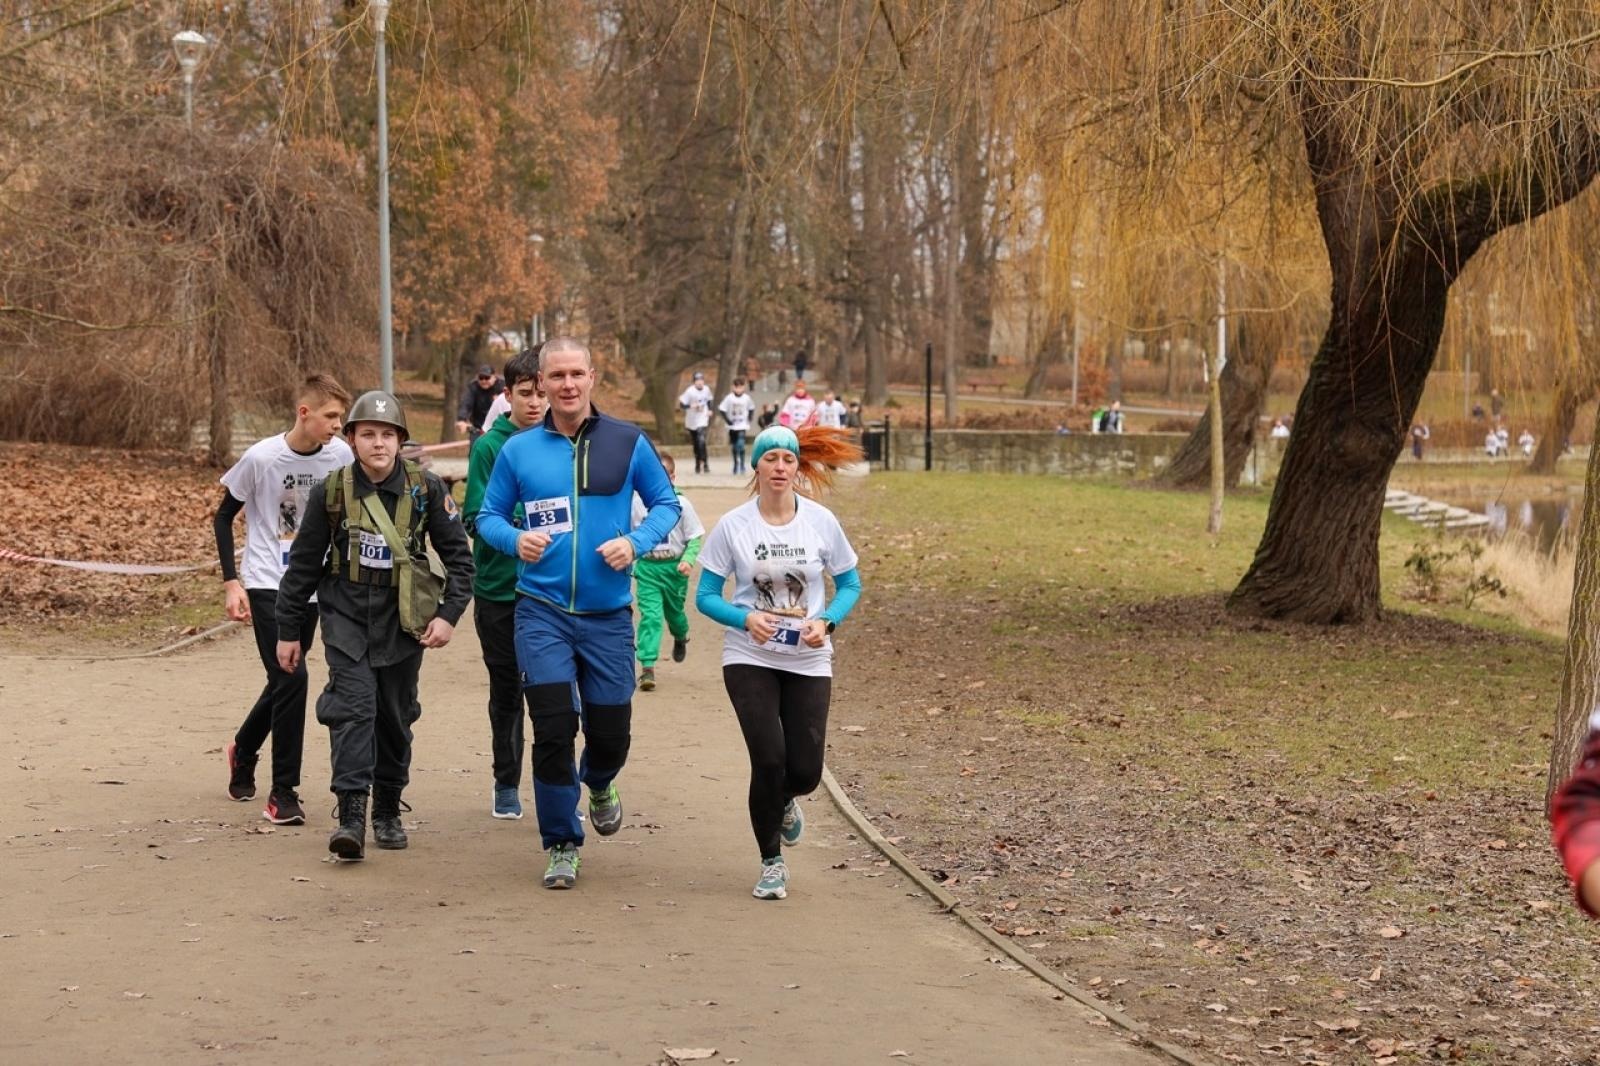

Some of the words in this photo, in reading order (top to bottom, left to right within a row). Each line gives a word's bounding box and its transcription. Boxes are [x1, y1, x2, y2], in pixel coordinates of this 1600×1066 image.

[539, 510, 556, 526] 33
[360, 544, 384, 560] 101
[770, 548, 806, 557] WILCZYM
